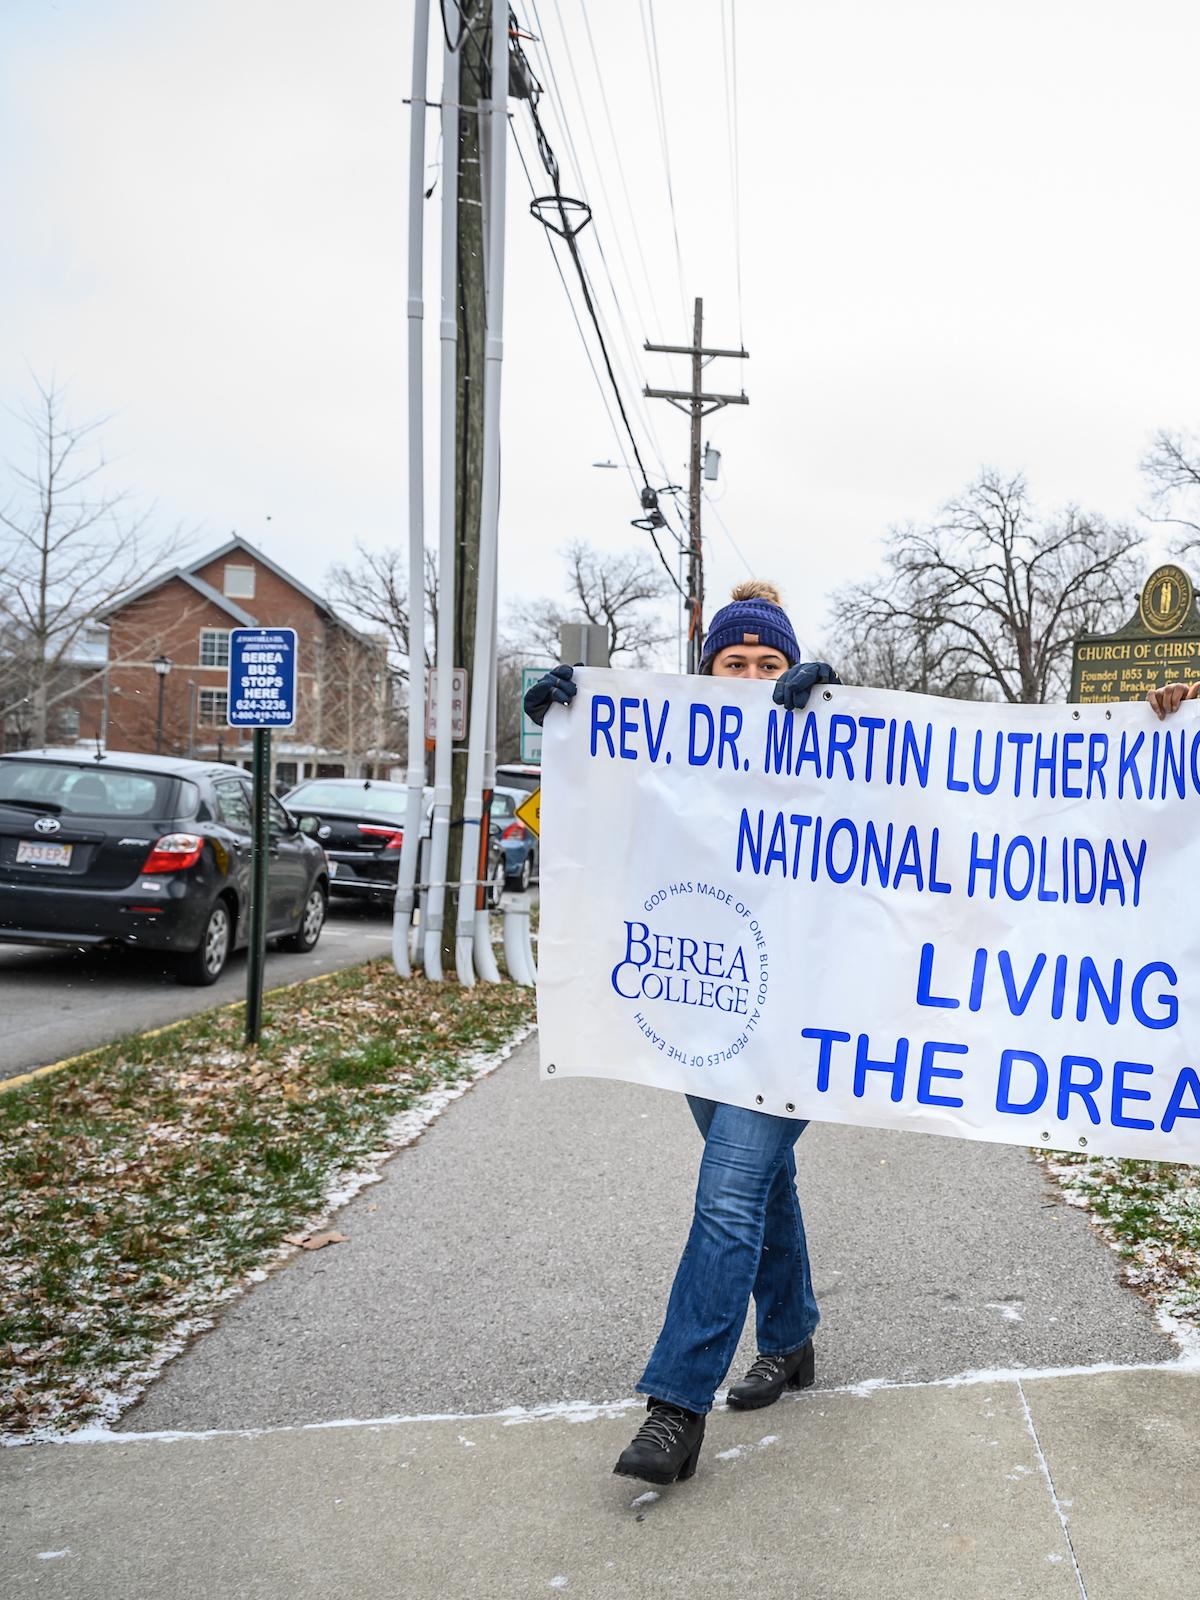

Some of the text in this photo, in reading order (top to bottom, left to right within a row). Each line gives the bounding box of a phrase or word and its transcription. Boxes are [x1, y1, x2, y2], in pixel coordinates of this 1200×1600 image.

[241, 652, 283, 663] BEREA
[1077, 644, 1131, 660] CHURCH
[1134, 644, 1151, 659] OF
[248, 664, 277, 675] BUS
[1081, 670, 1118, 681] Founded
[1121, 668, 1142, 680] 1853
[1146, 668, 1159, 680] by
[1164, 668, 1179, 679] the
[241, 676, 283, 687] STOPS
[1080, 682, 1096, 693] Fee
[1101, 682, 1113, 693] of
[1120, 680, 1156, 693] Bracken
[244, 688, 279, 699] HERE
[235, 699, 287, 710] 624-3236
[591, 695, 672, 765] REV.
[688, 703, 750, 772] DR.
[764, 709, 933, 788] MARTIN
[947, 726, 1108, 800] LUTHER
[736, 808, 1147, 907] NATIONAL HOLIDAY
[623, 920, 750, 983] BEREA
[633, 881, 769, 1067] GOD HAS MADE OF ONE BLOOD ALL PEOPLES OF THE EARTH
[611, 961, 749, 1015] COLLEGE
[916, 942, 1179, 1030] LIVING
[801, 1027, 969, 1108] THE
